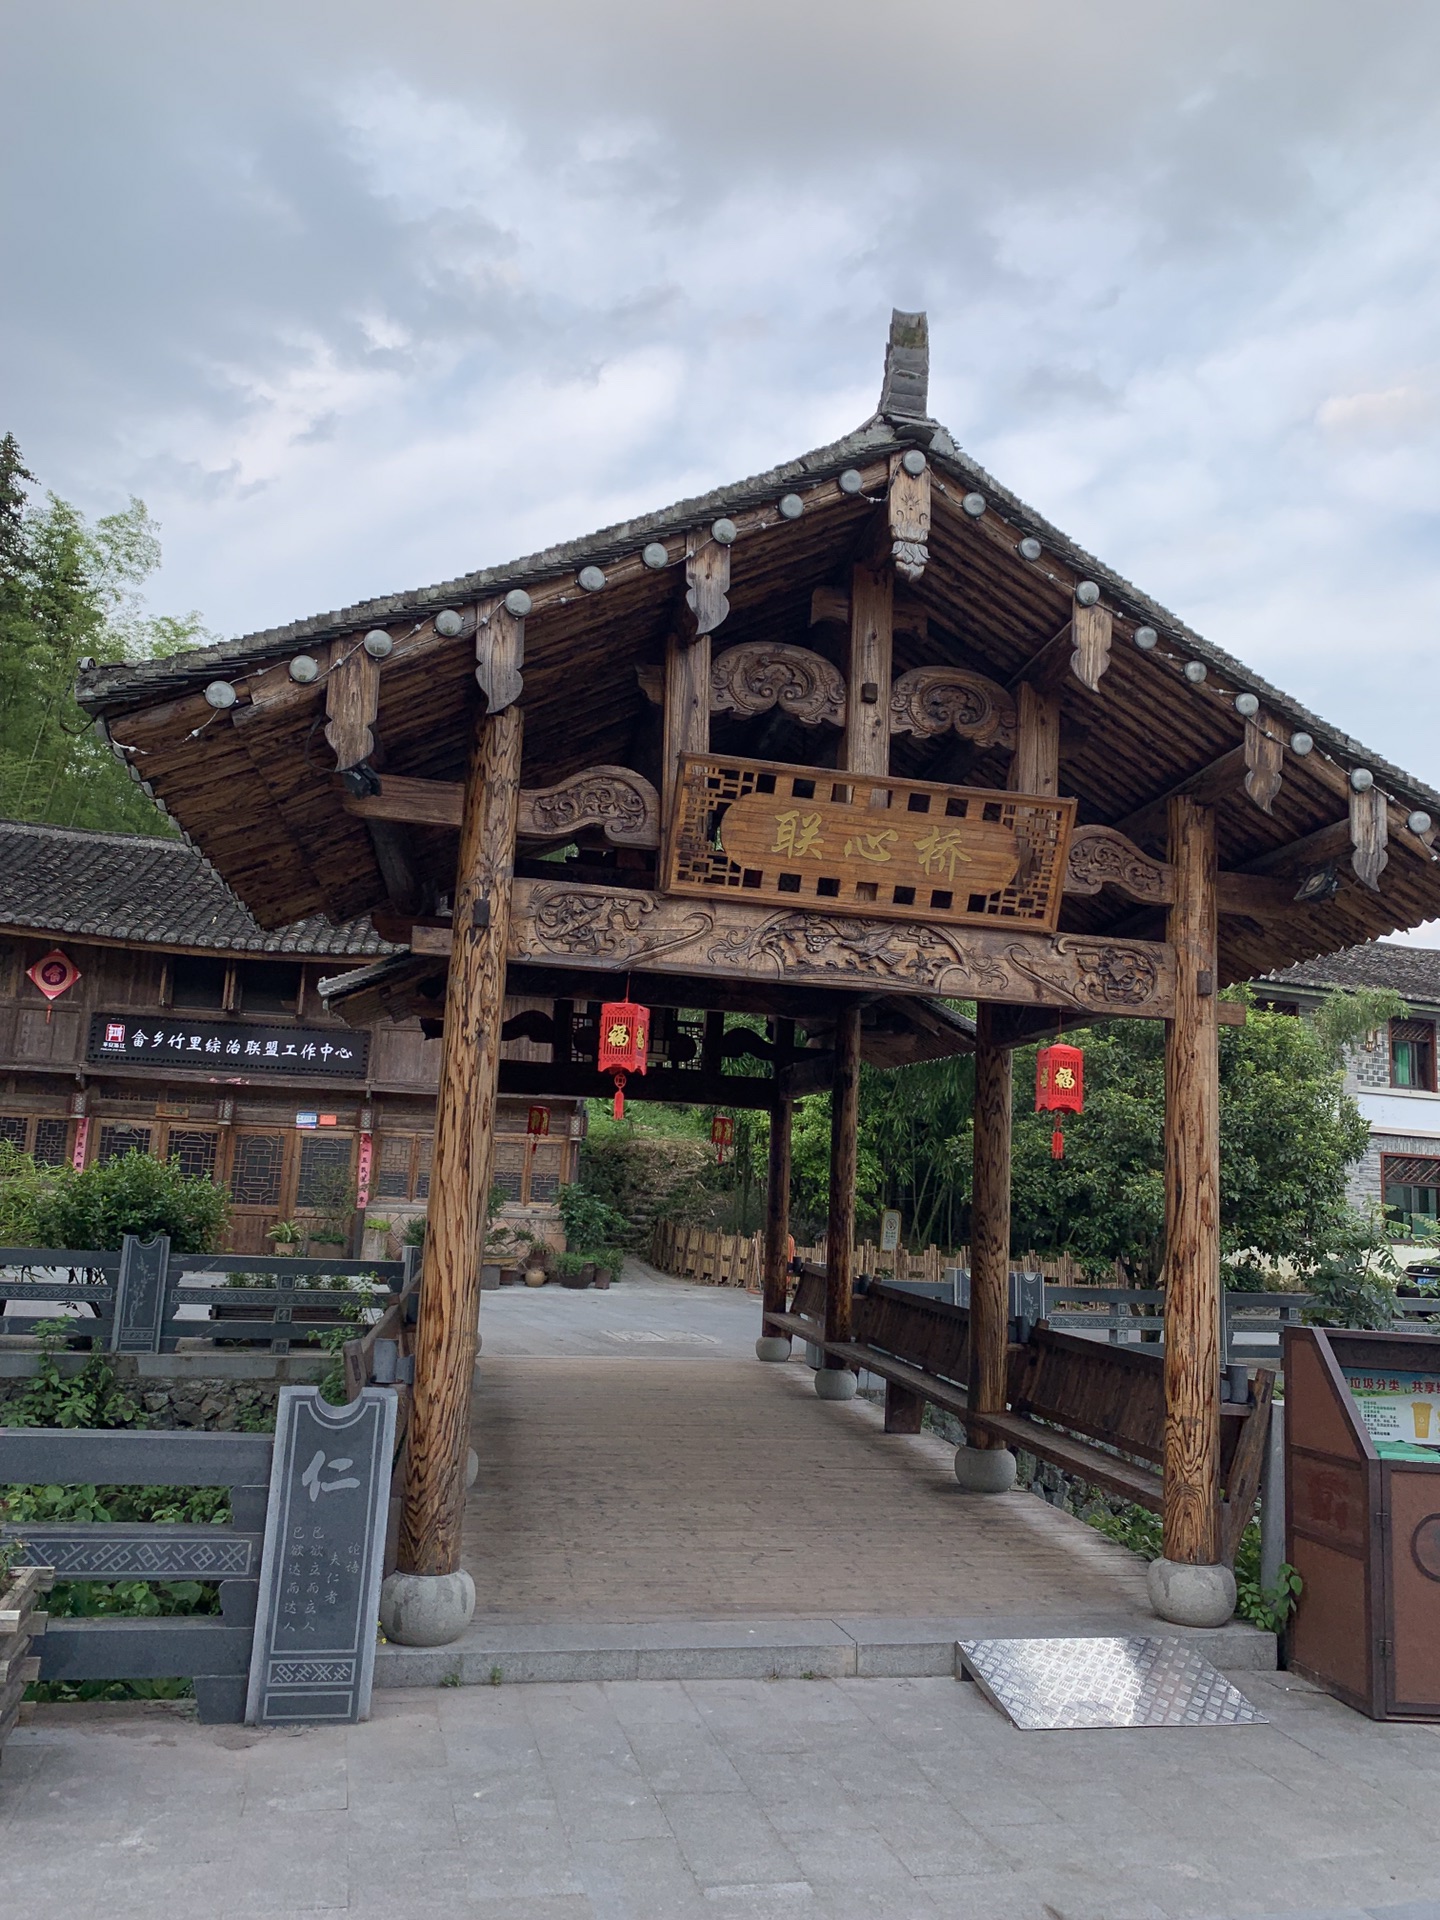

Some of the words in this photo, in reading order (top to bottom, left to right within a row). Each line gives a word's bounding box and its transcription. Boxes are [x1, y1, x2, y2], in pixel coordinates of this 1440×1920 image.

[771, 810, 972, 882] 联心桥
[608, 1024, 629, 1047] 福
[1054, 1067, 1076, 1089] 福
[1344, 1376, 1400, 1392] 垃圾分类
[1411, 1381, 1440, 1394] 共享
[302, 1449, 361, 1502] 仁
[345, 1542, 361, 1574] 论语
[325, 1551, 341, 1605] 夫仁者
